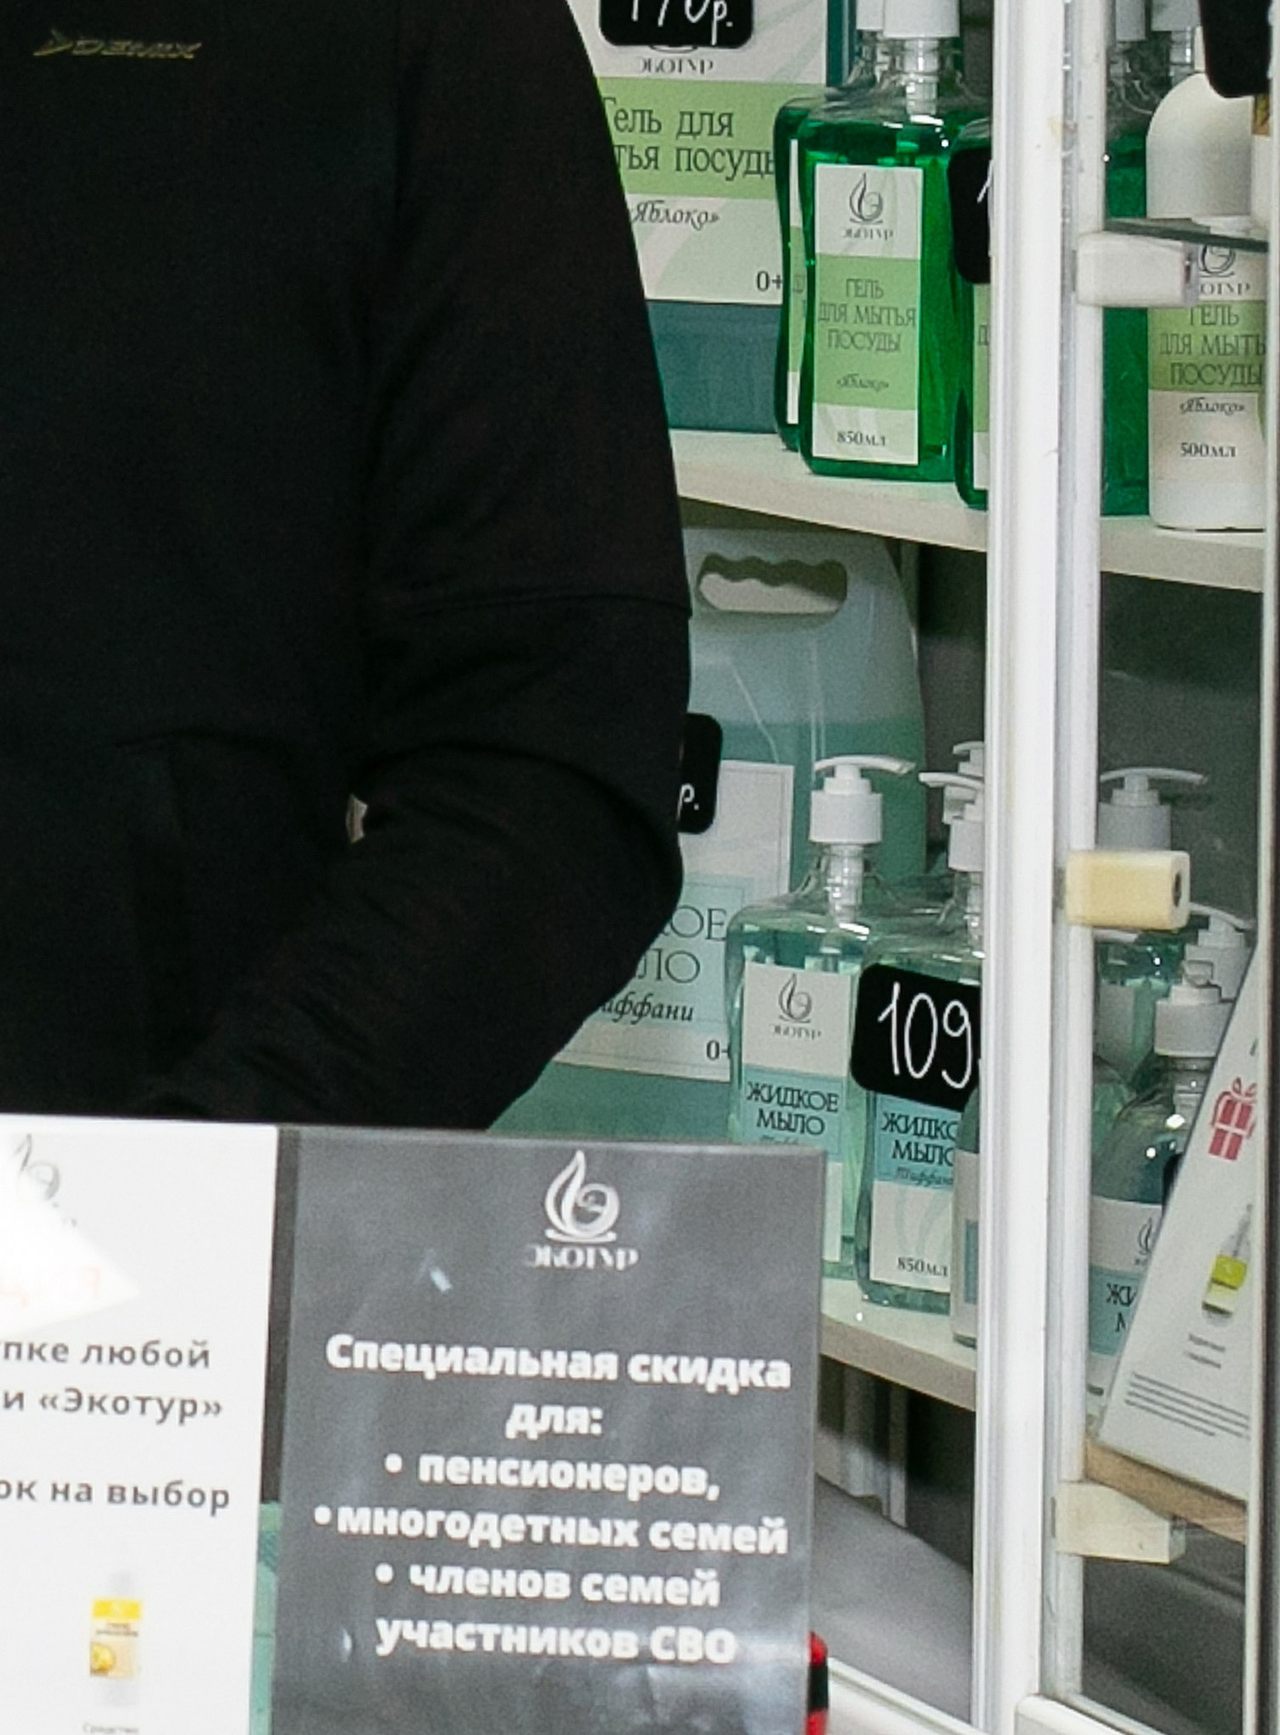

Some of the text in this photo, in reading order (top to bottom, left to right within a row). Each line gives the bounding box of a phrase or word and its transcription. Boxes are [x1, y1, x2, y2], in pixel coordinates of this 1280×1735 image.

[602, 96, 734, 140] Гель для
[613, 145, 660, 171] тья
[756, 270, 782, 293] 0+
[846, 278, 884, 300] ГЕЛЬ
[1200, 282, 1251, 296] ОТУР
[818, 302, 917, 327] ДЛЯ МЫТЬЯ
[1188, 303, 1240, 327] ГЕЛЬ
[827, 328, 902, 354] ПОСУДЫ
[1201, 333, 1267, 357] МЫТЬ
[1170, 362, 1262, 386] ПОСУДЫ
[1180, 442, 1237, 459] 500мл
[638, 948, 701, 984] ЛО
[746, 1080, 839, 1113] ЖИДКОЕ
[756, 1108, 825, 1136] МЫЛО
[881, 1112, 958, 1142] ЖИДКО
[81, 1339, 211, 1369] любой
[325, 1332, 792, 1395] Специальная скидка
[40, 1387, 224, 1426] «Экотур»
[505, 1402, 604, 1440] для:
[419, 1453, 720, 1501] пенсионеров,
[50, 1480, 93, 1504] на
[108, 1478, 231, 1517] выбор
[336, 1505, 789, 1555] многодетных семей
[409, 1564, 720, 1607] членов семей
[375, 1617, 738, 1664] участников СВО
